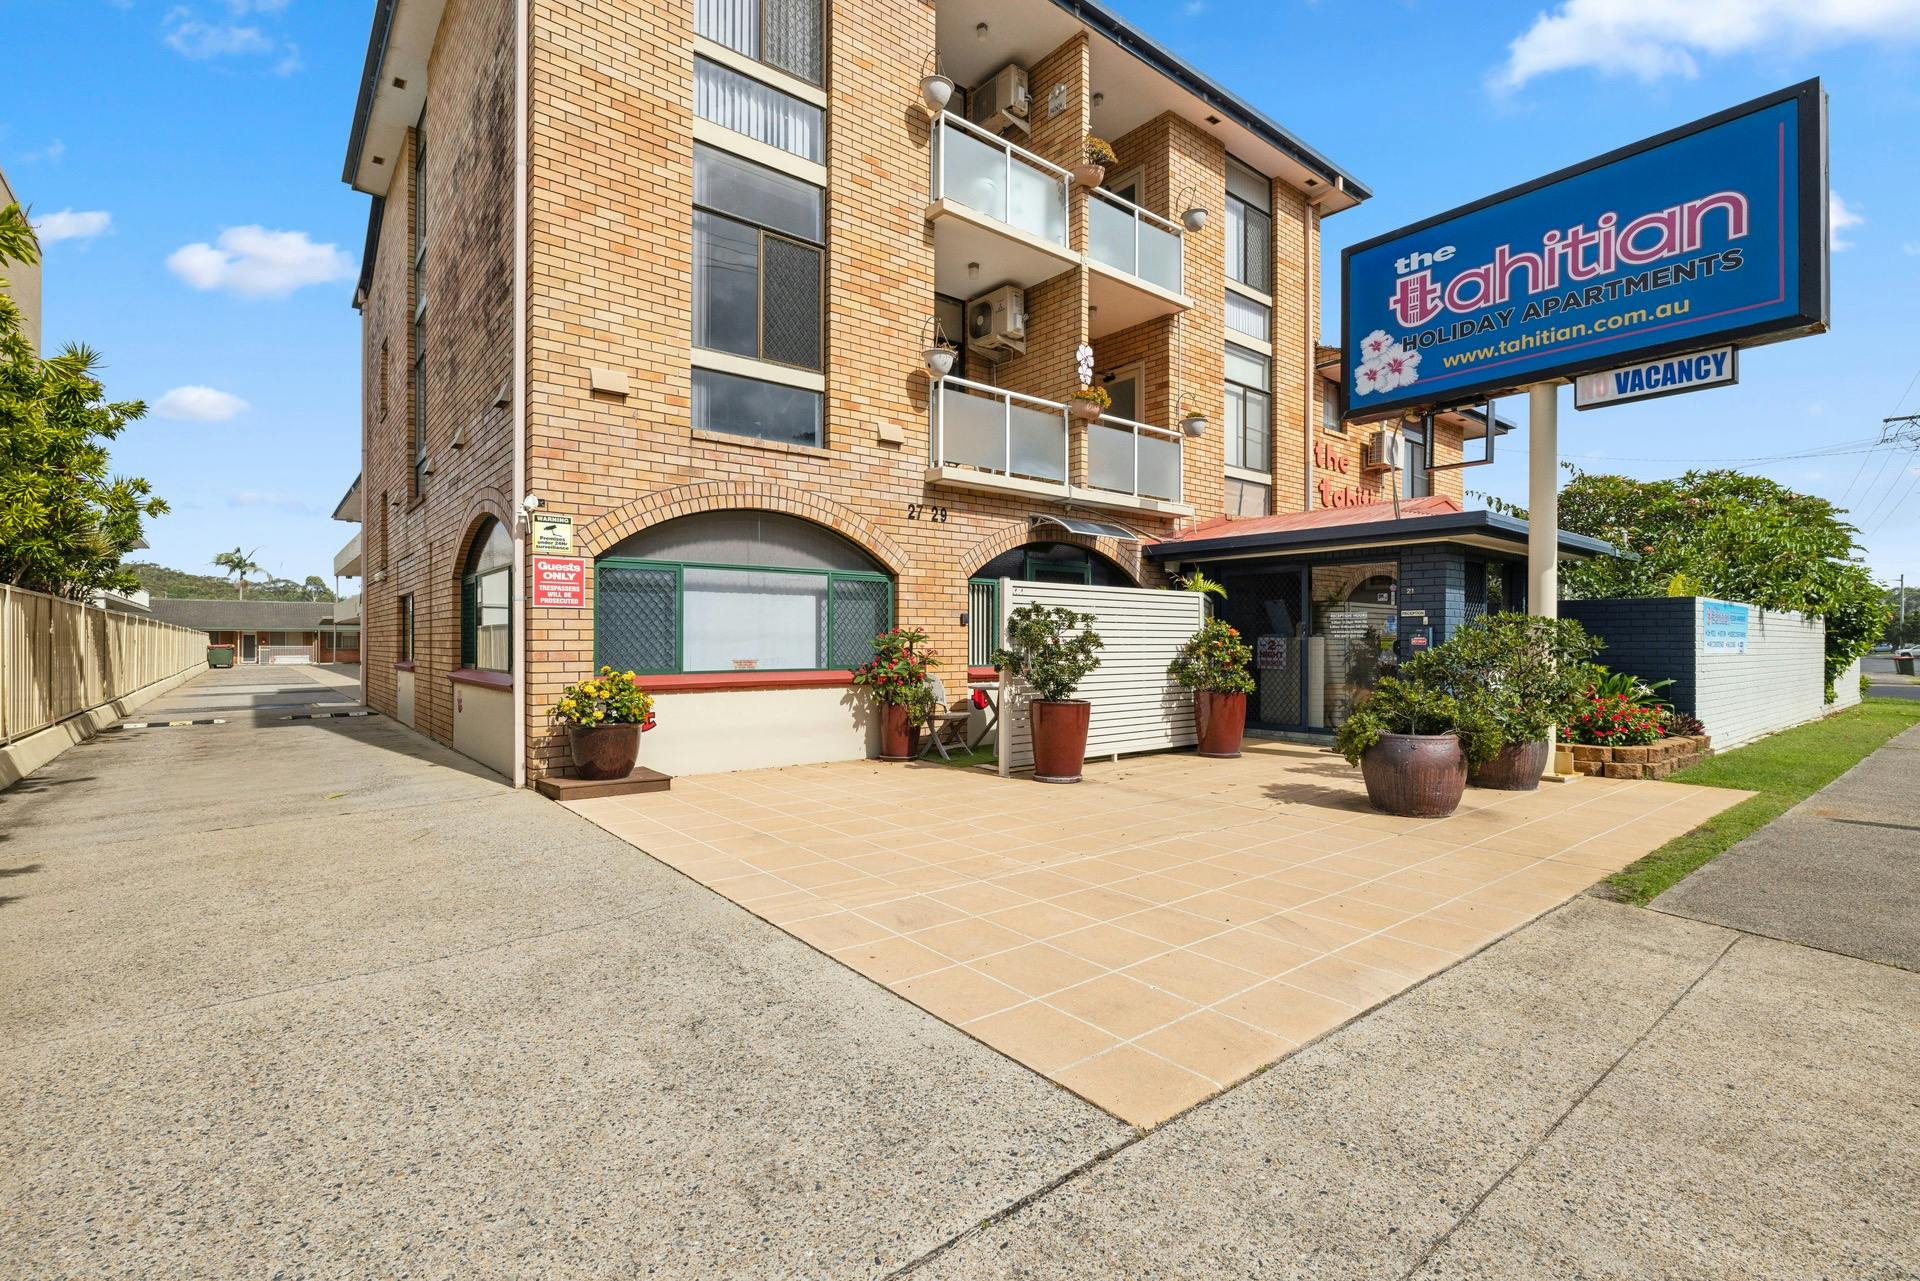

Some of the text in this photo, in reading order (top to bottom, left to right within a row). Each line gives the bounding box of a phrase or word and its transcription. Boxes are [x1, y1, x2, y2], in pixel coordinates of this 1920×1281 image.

[1389, 191, 1748, 328] tahitian
[1395, 245, 1457, 275] the
[1402, 248, 1744, 352] HOLIDAY APARTMENTS
[1443, 299, 1690, 369] www.tahitian.com.au
[1615, 351, 1728, 395] VACANCY
[1314, 440, 1350, 474] the
[536, 515, 570, 524] WARNING
[908, 503, 948, 523] 27 29
[537, 561, 581, 572] Guests
[542, 571, 577, 581] ONLY
[539, 584, 580, 592] TRESPASSERS
[540, 597, 579, 605] PROSECUTED
